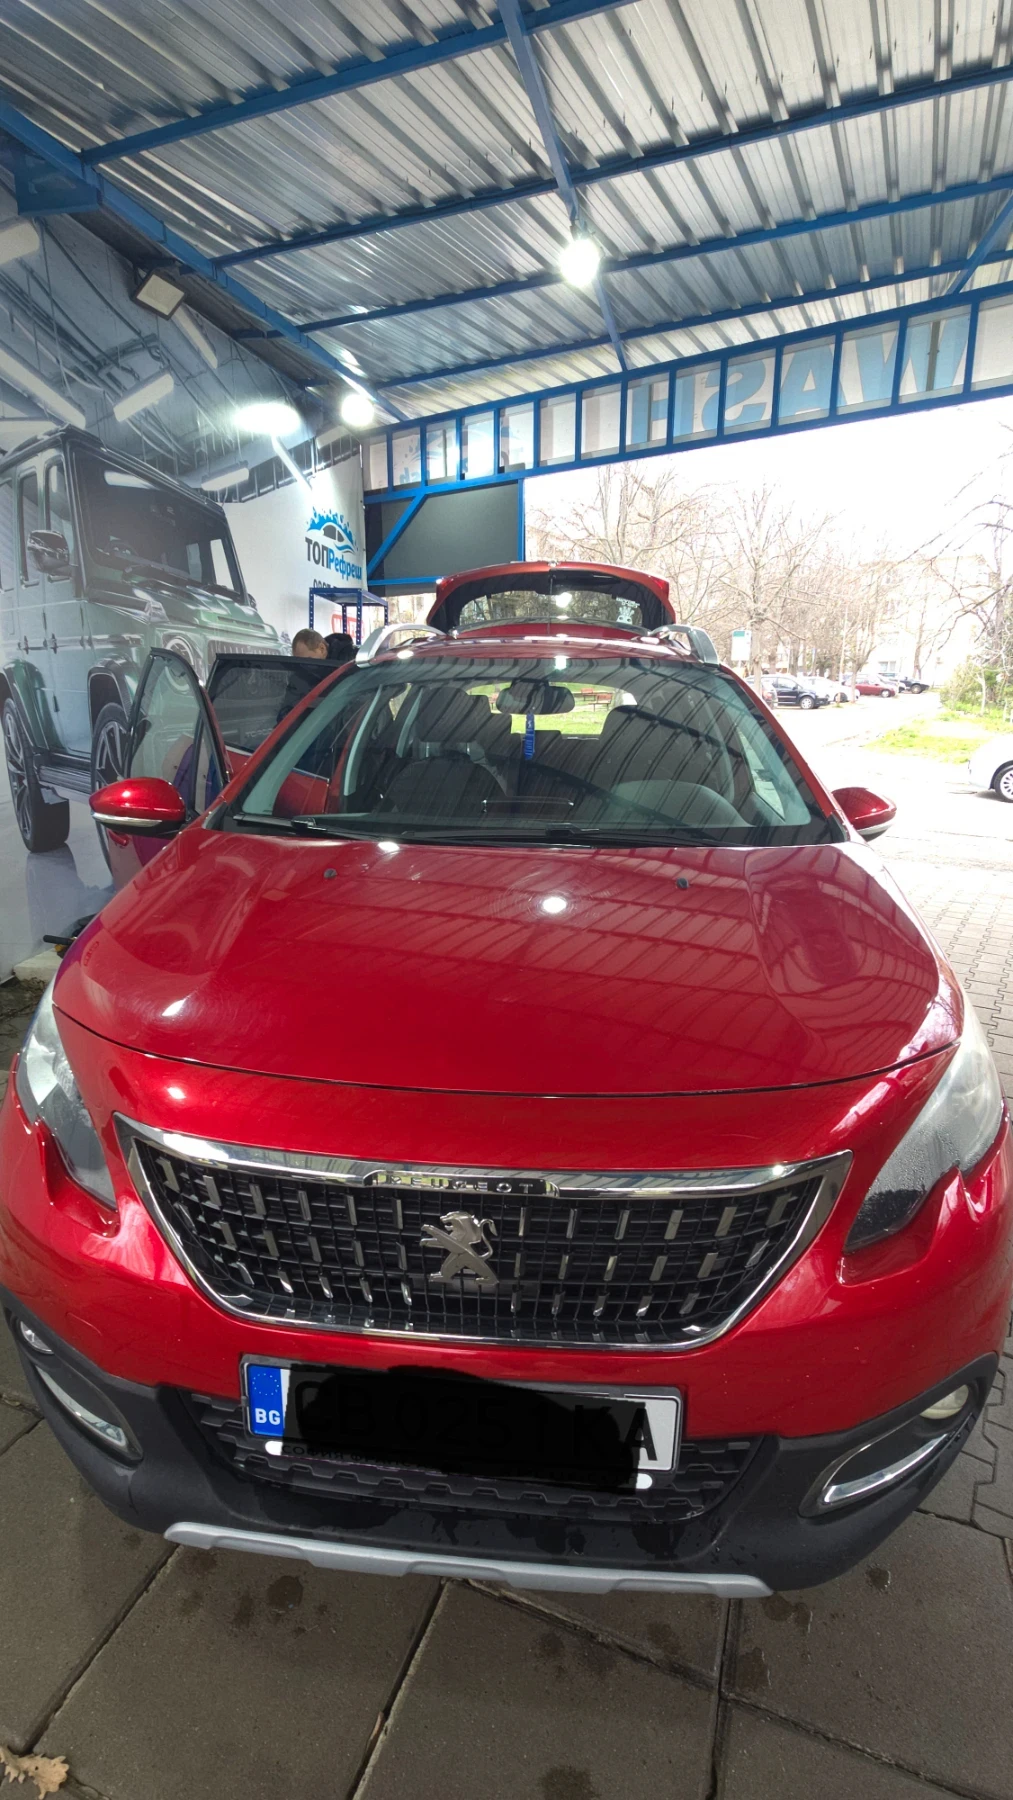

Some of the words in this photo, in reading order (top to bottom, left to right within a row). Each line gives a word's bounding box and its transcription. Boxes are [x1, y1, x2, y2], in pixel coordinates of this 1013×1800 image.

[305, 536, 362, 581] ТОПРефреш
[390, 1174, 534, 1195] PEUGEOT
[255, 1408, 281, 1425] BG
